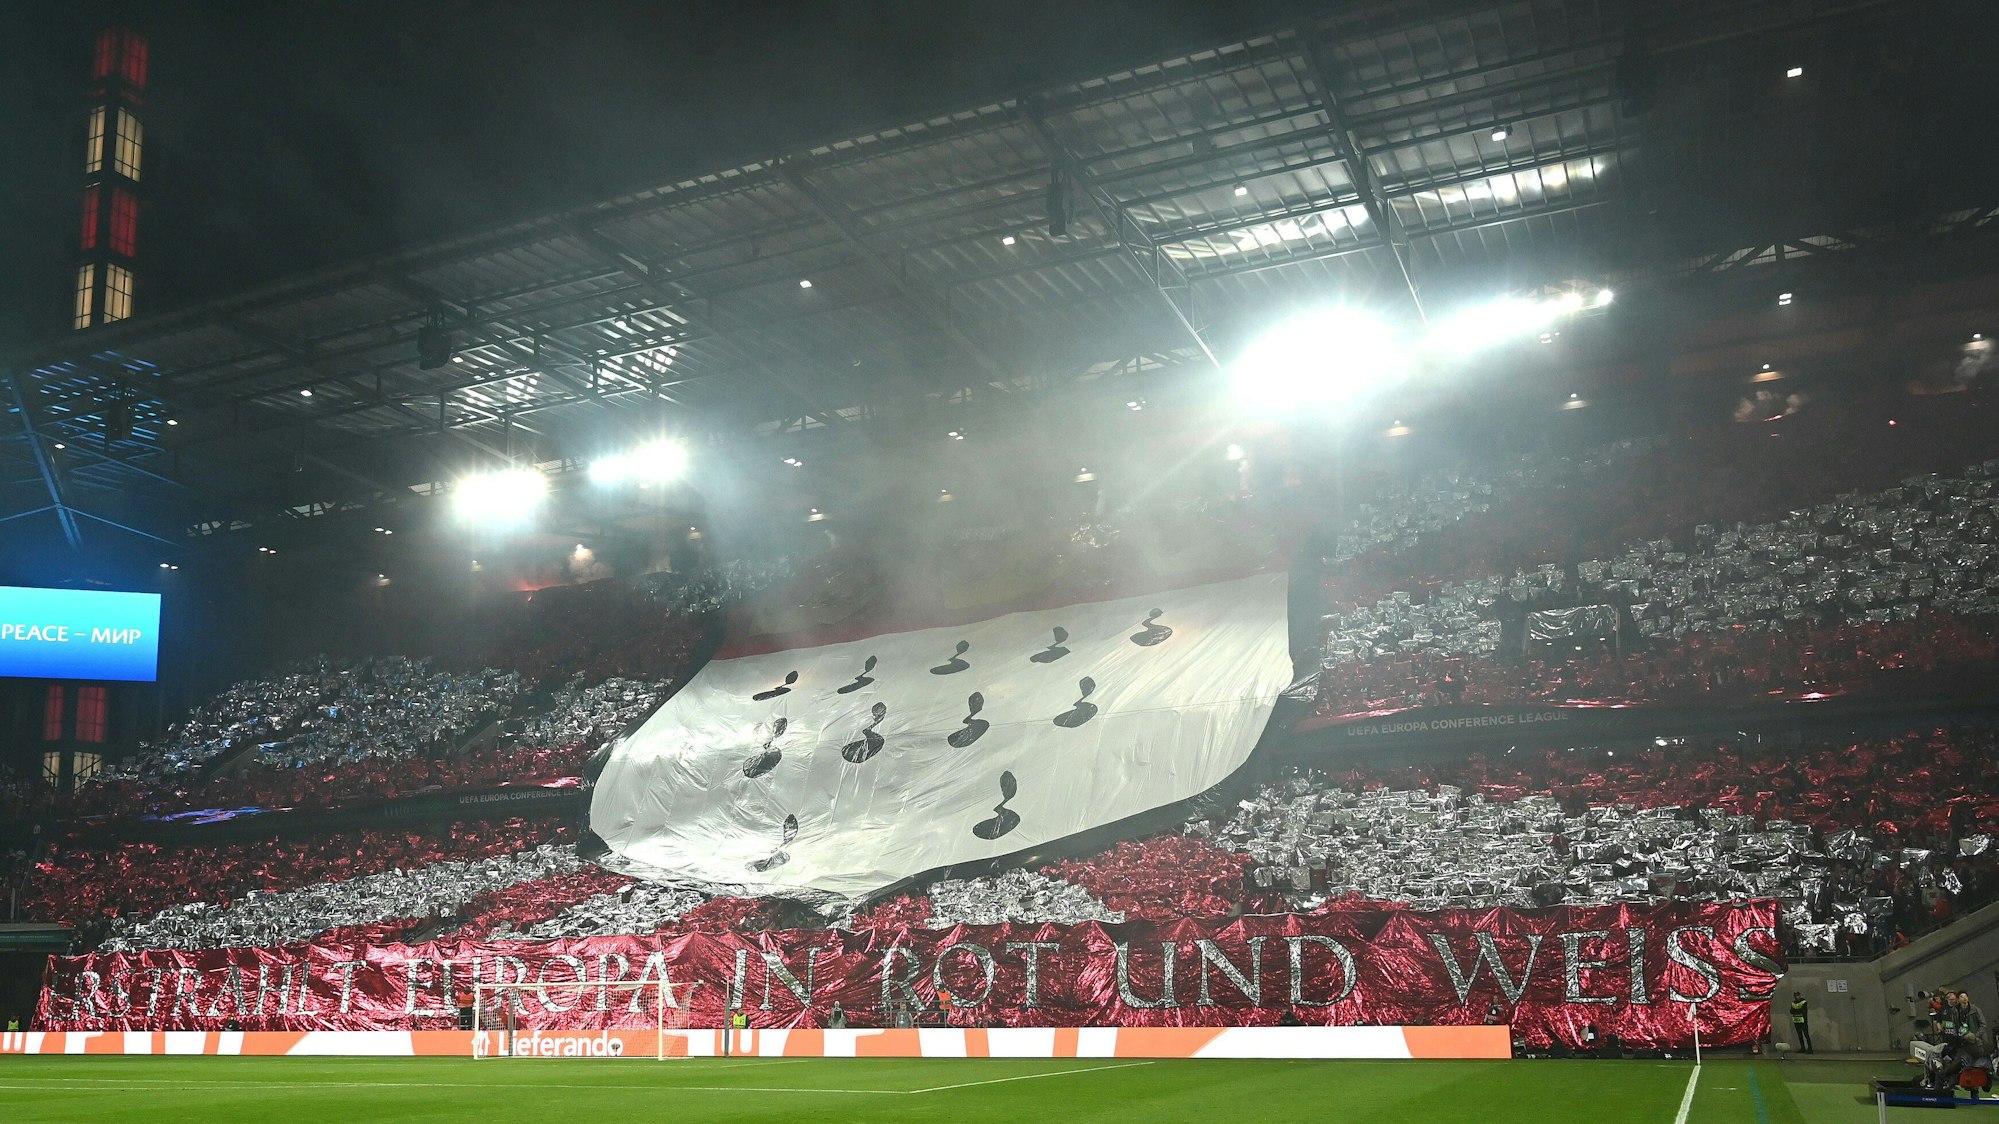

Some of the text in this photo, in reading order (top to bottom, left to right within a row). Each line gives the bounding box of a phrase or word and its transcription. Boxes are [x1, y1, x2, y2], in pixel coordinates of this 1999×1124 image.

[1, 624, 69, 642] PEACE
[91, 628, 142, 645] МИР
[1347, 710, 1569, 736] UEFA EUROPA CONFERENCE LEAGUE
[459, 795, 479, 804] UEFA
[480, 793, 509, 803] EUROPA
[510, 789, 562, 801] CONFERENCE
[403, 951, 679, 1017] EUROPA
[730, 947, 826, 1012] IN
[880, 942, 1061, 1012] ROT
[1113, 934, 1358, 1010] UND
[1426, 925, 1789, 1007] WEISS
[498, 1030, 624, 1057] Lieferando
